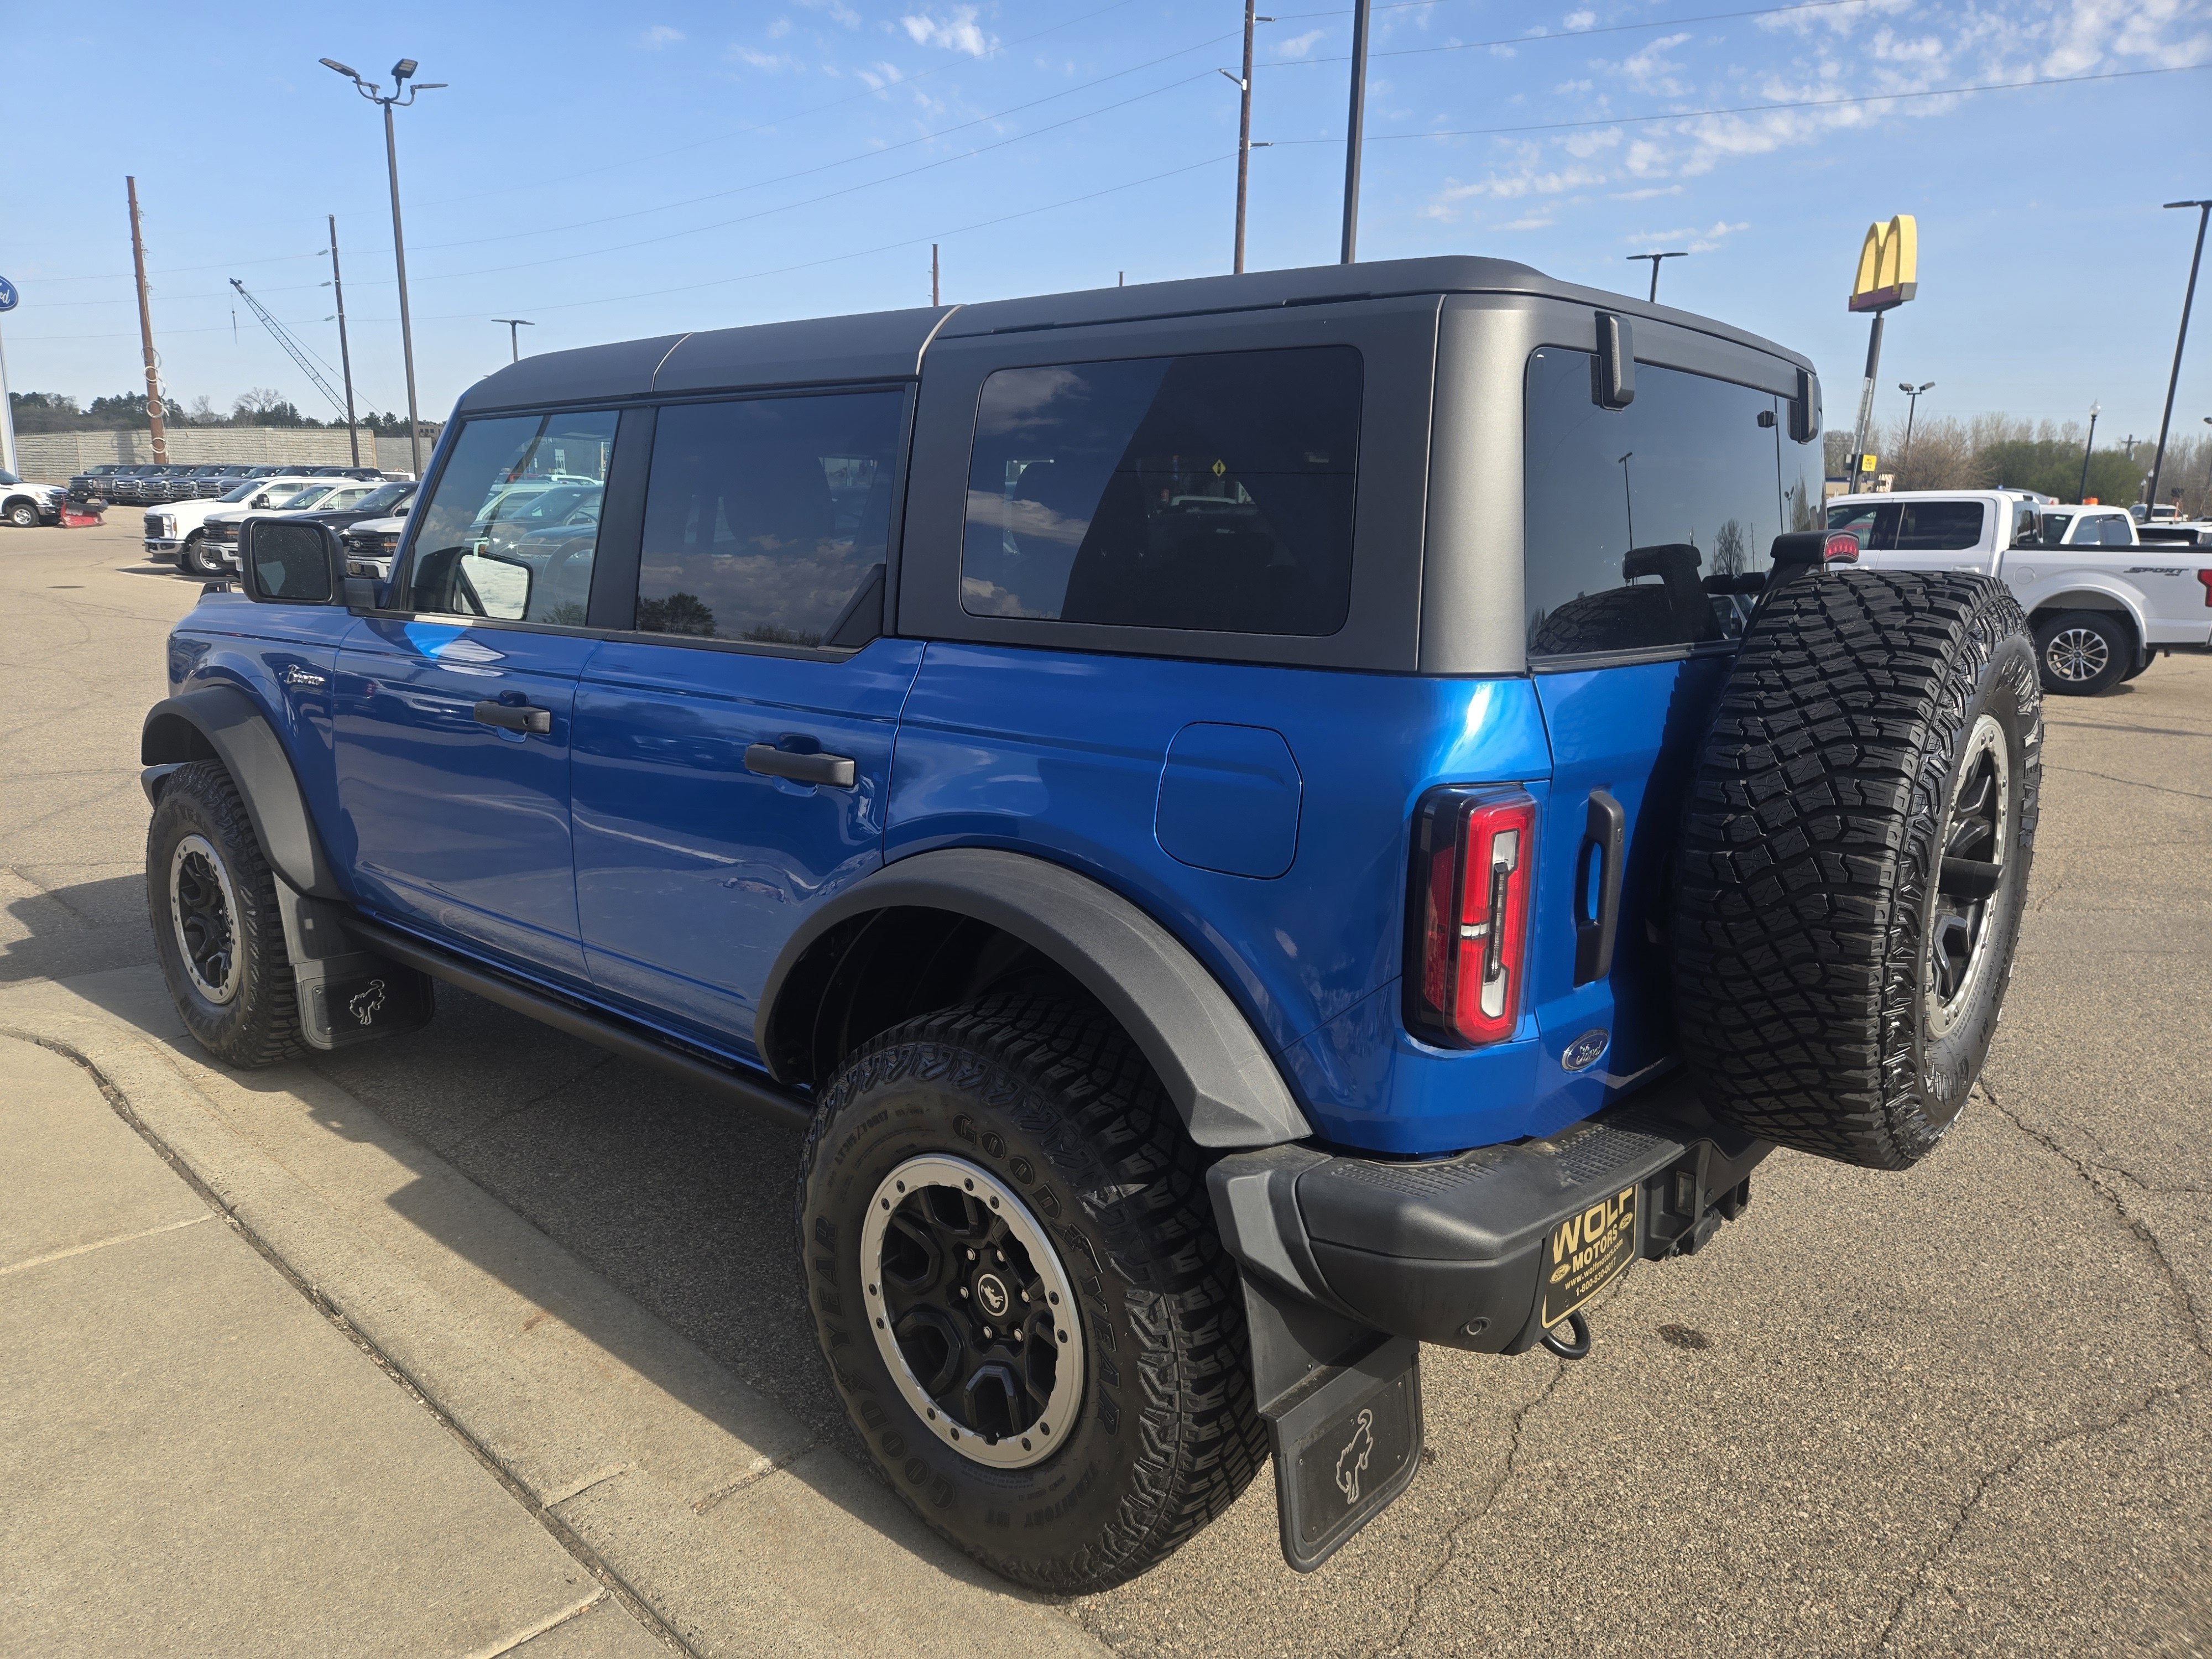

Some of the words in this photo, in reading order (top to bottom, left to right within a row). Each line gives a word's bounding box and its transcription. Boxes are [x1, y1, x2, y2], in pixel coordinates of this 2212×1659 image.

[2123, 567, 2189, 576] SPORT
[1575, 1040, 1603, 1065] Ford
[1564, 1238, 1624, 1291] www.wolfmotors.com
[1573, 1223, 1618, 1273] MOTORS
[1576, 1256, 1617, 1296] 1-800-830-0017
